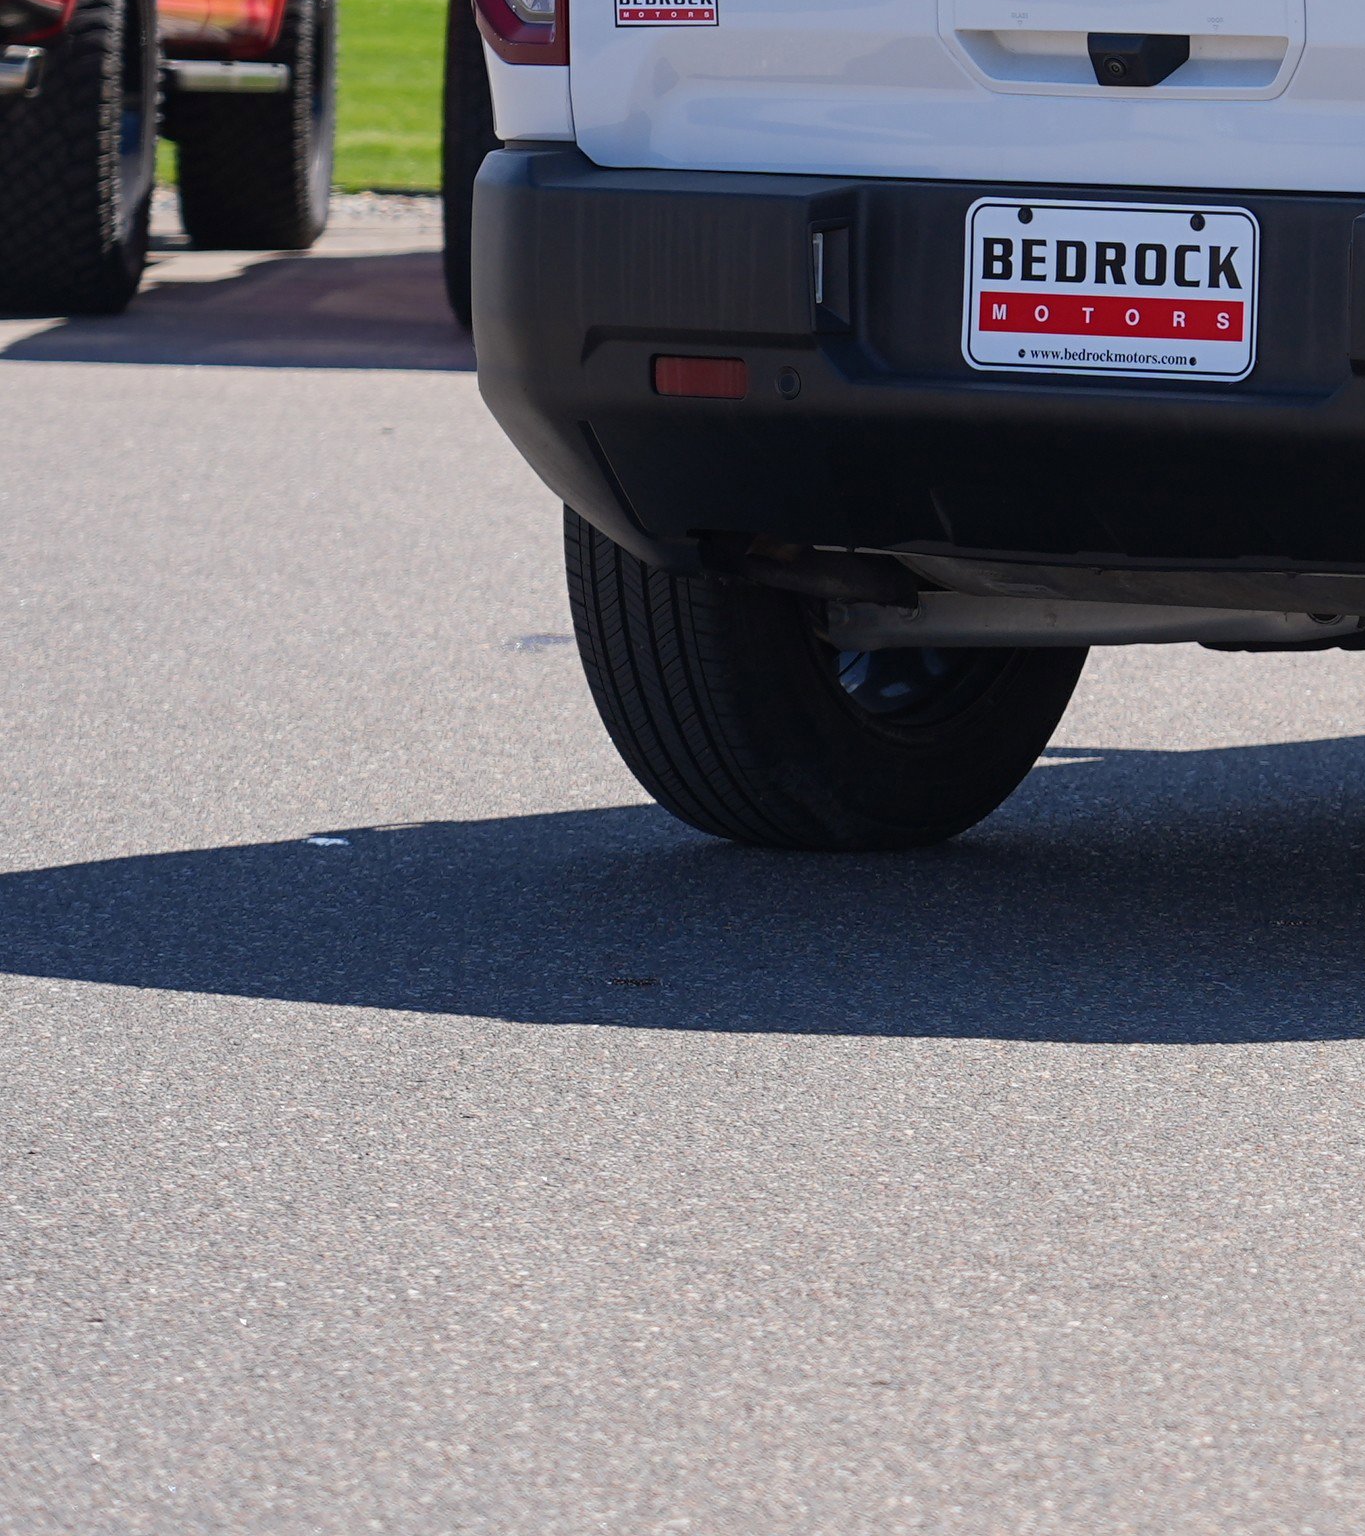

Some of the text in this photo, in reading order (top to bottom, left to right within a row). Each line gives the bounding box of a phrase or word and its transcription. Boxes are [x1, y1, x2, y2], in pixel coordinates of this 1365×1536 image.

[623, 11, 710, 19] MOTORS
[982, 237, 1243, 289] BEDROCK
[992, 303, 1230, 330] MOTORS
[1030, 348, 1187, 365] www.bedrockmotors.com
